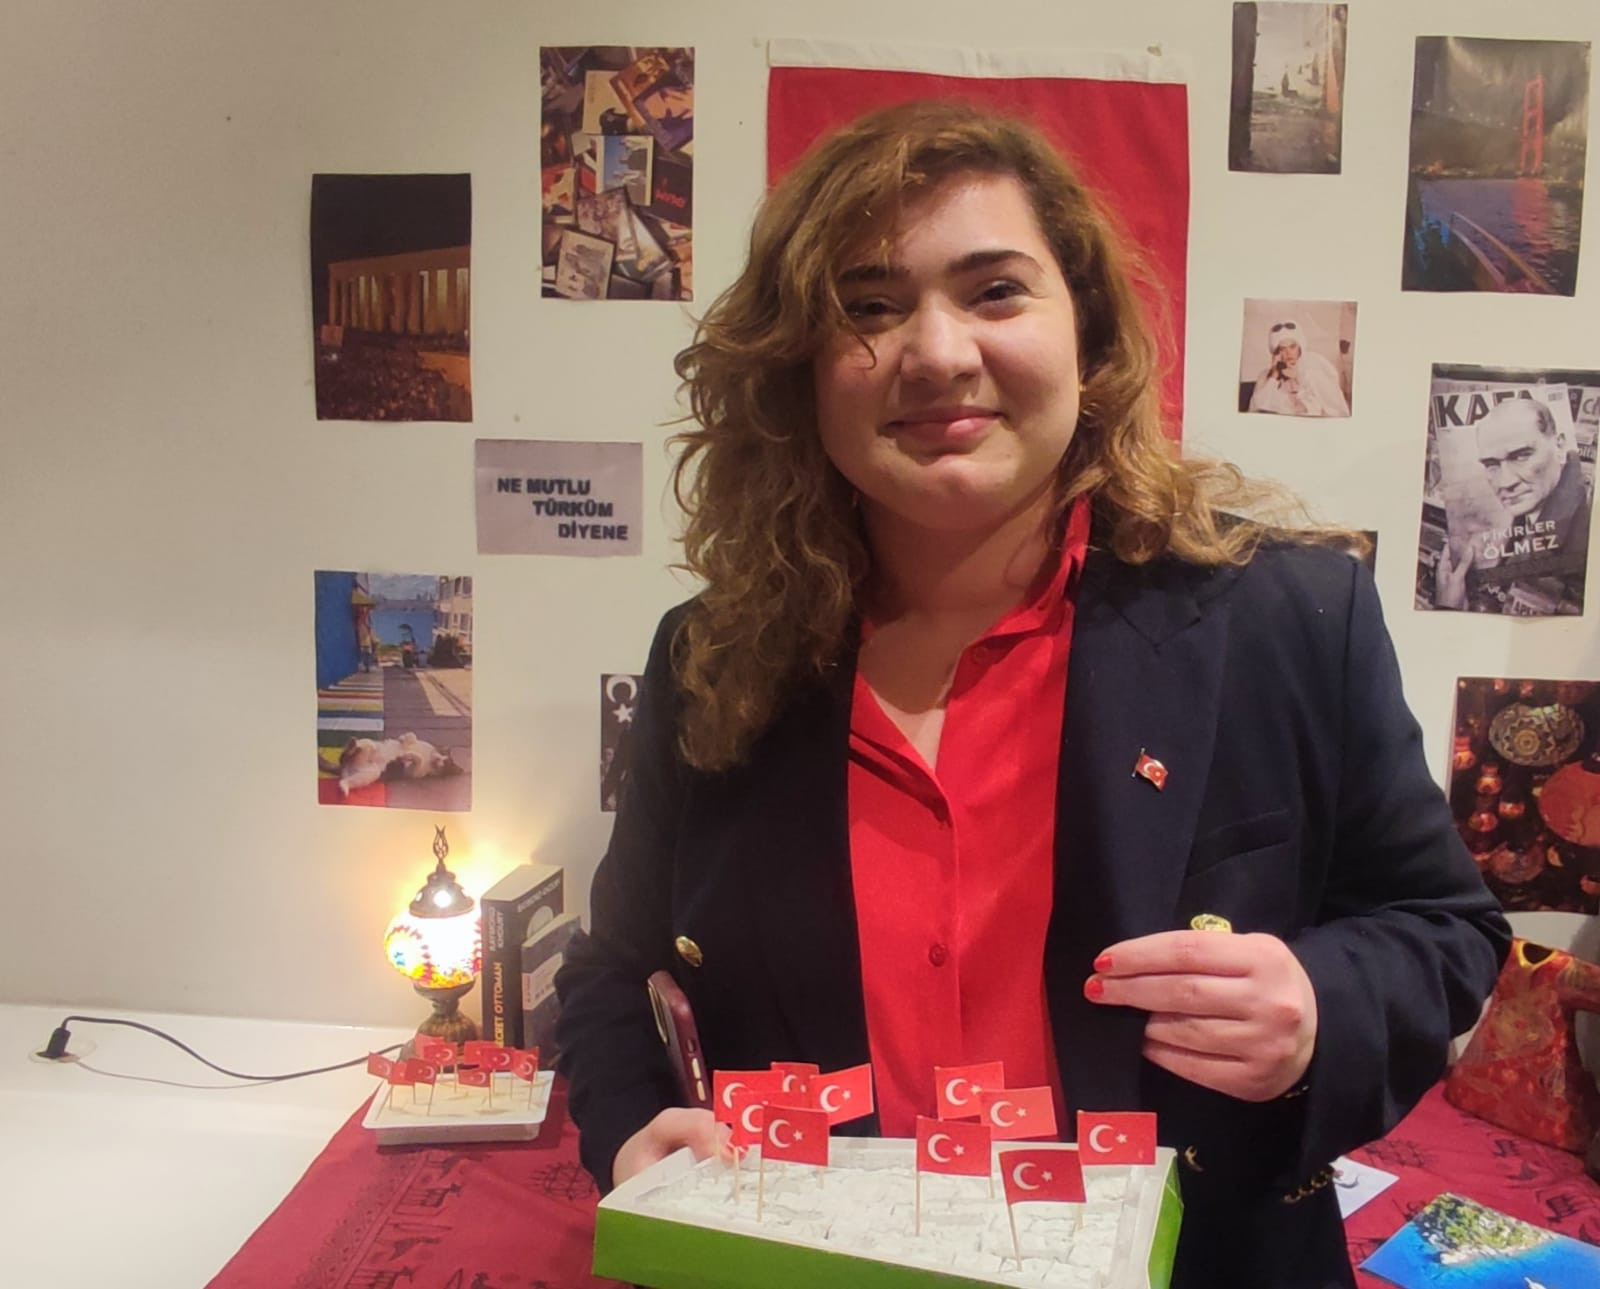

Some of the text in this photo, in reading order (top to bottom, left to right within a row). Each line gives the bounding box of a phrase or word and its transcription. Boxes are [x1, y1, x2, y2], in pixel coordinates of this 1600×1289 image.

[497, 478, 591, 495] NE MUTLU
[532, 498, 613, 517] TÜRKÜM
[558, 520, 628, 540] DİYENE
[1484, 534, 1559, 559] ÖLMEZ
[493, 961, 504, 1014] OTTOMAN
